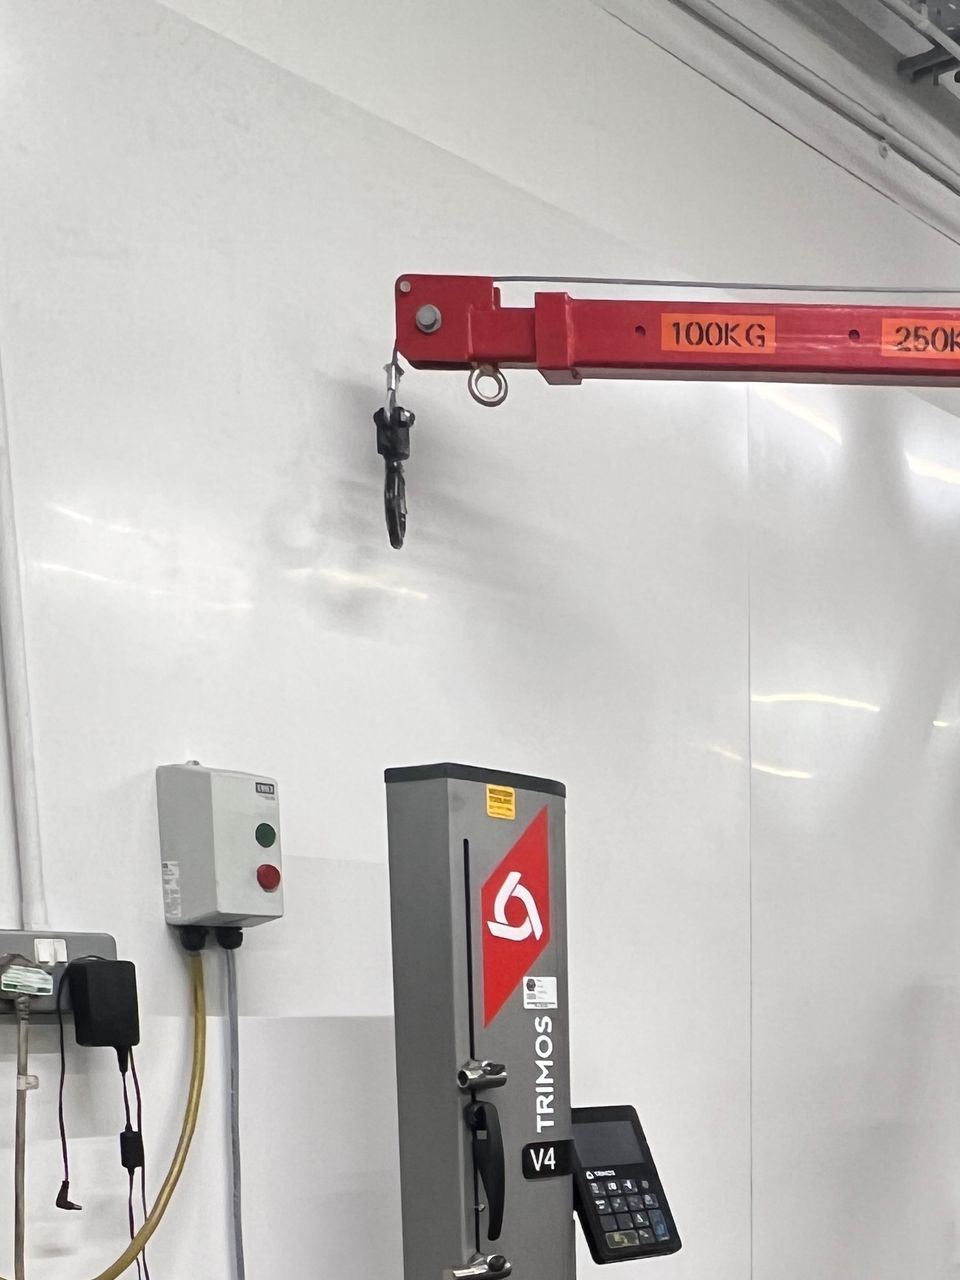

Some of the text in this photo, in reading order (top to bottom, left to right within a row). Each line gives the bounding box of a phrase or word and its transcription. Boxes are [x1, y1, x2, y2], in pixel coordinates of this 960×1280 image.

[672, 322, 766, 347] 100KG
[534, 1015, 555, 1133] TRIMOS
[529, 1146, 556, 1172] V4
